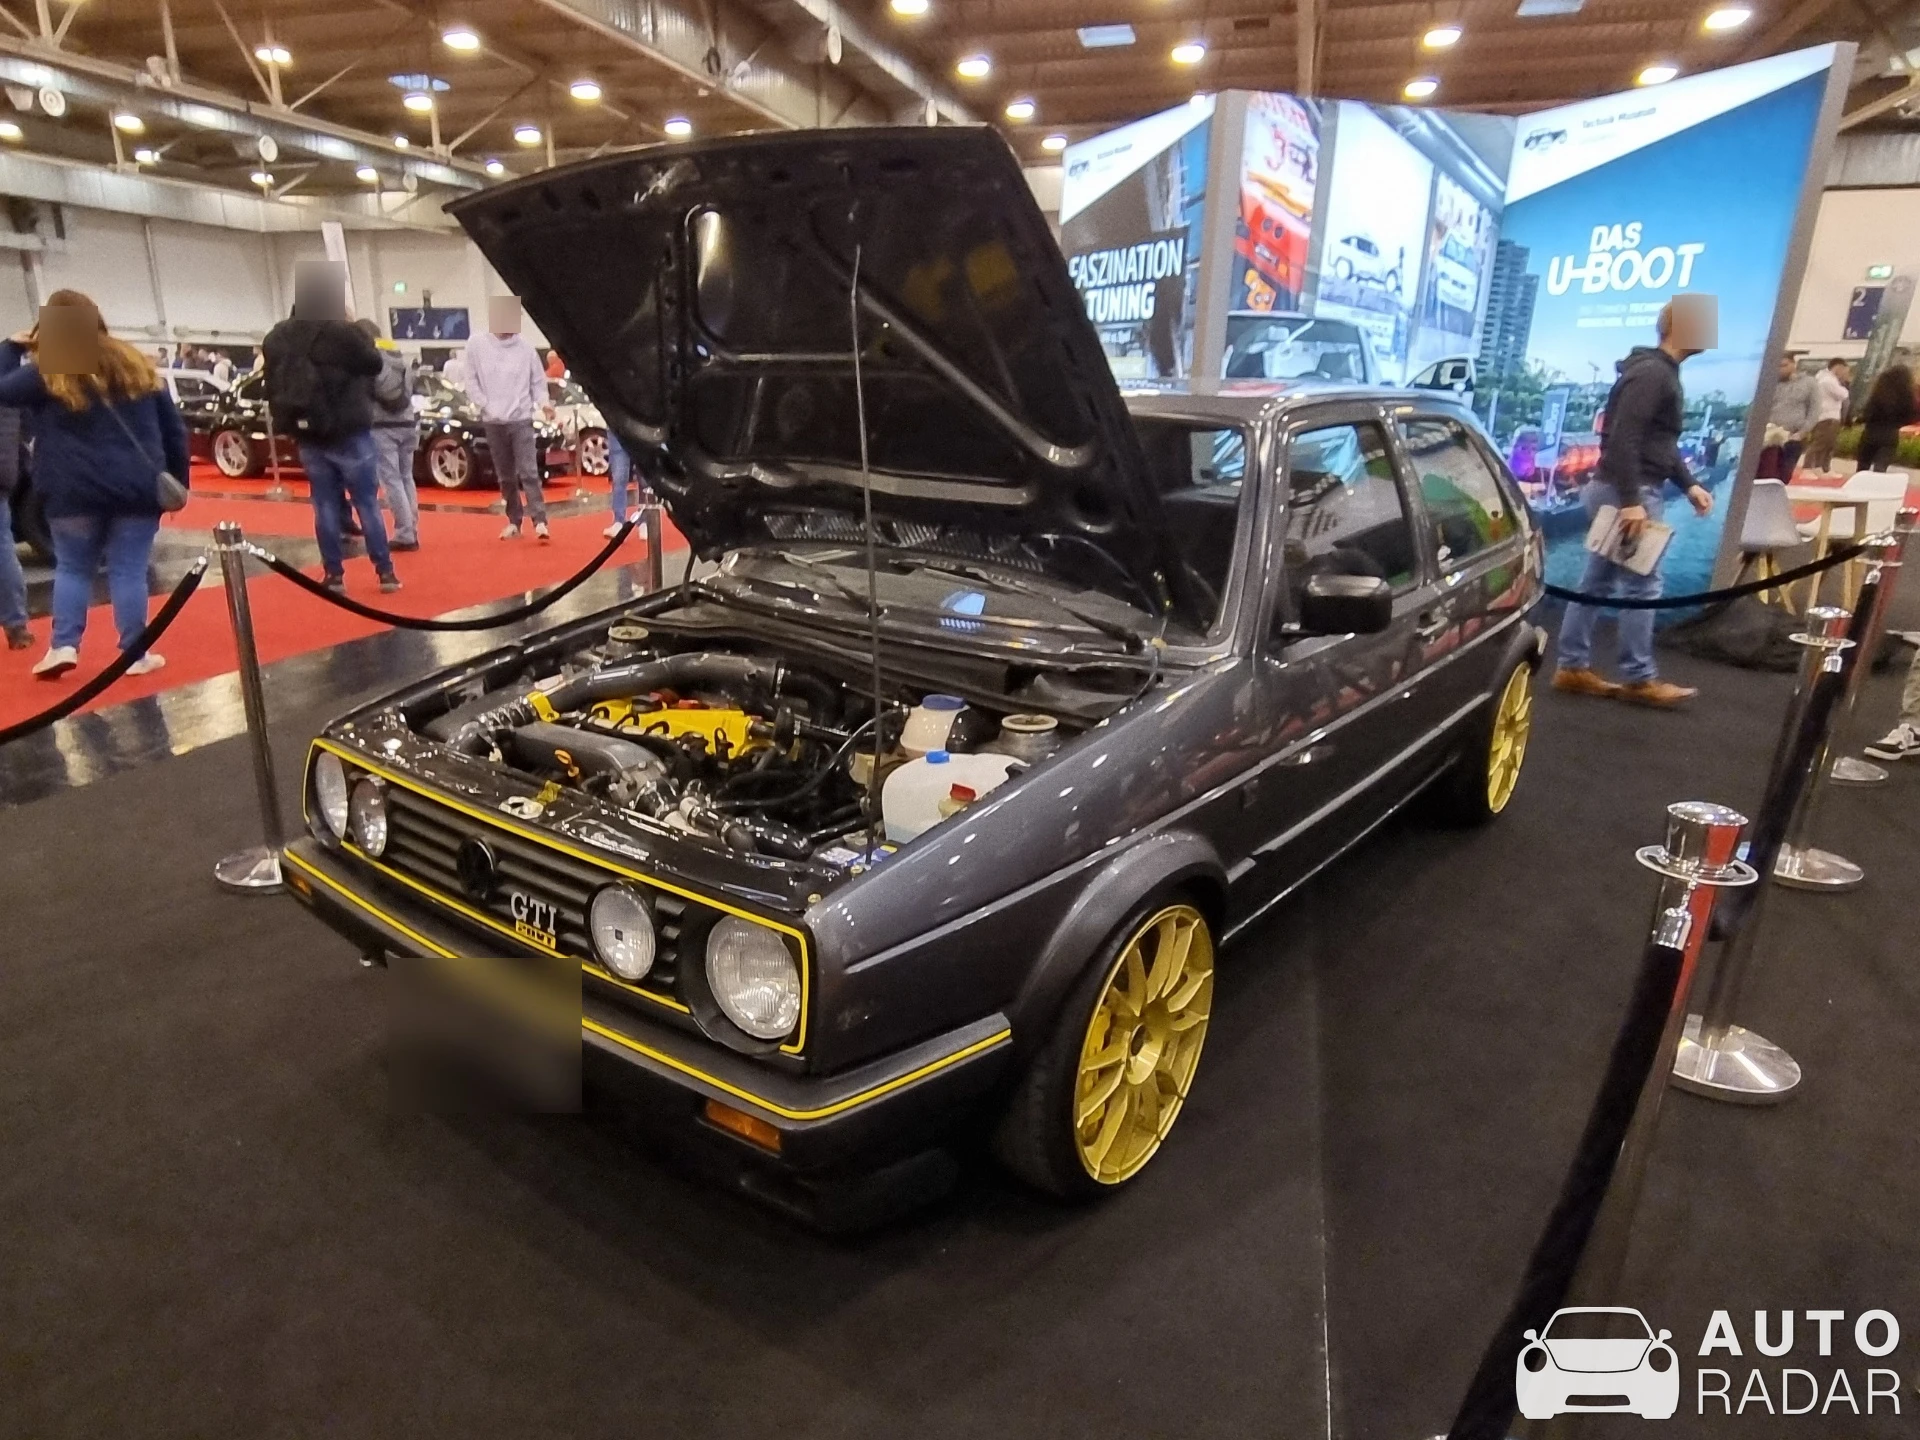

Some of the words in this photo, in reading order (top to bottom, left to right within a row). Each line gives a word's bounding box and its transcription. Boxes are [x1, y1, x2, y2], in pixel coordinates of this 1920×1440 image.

[1590, 221, 1643, 252] DAS
[1068, 237, 1185, 289] FASZINATION
[1547, 242, 1706, 295] U-BOOT
[1084, 281, 1156, 322] TUNING
[1853, 288, 1867, 307] 2
[510, 891, 557, 936] GTI
